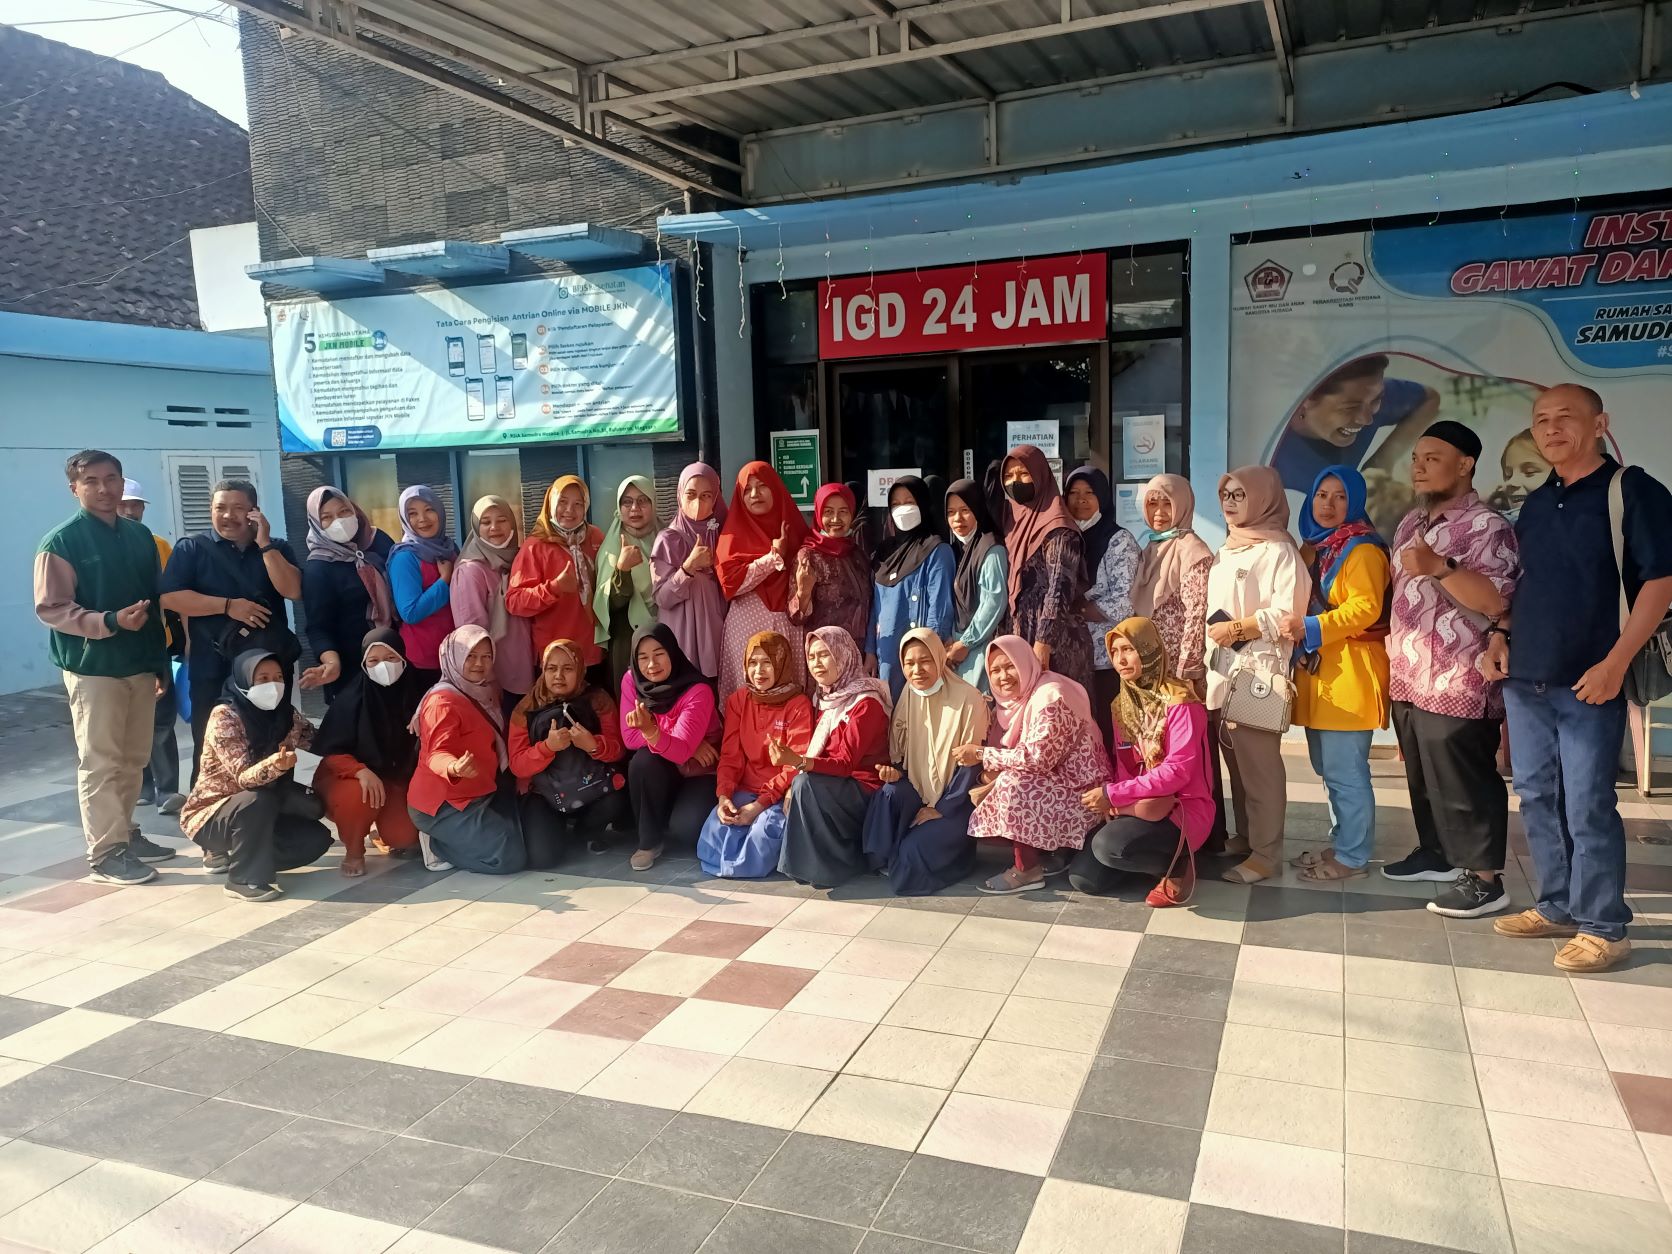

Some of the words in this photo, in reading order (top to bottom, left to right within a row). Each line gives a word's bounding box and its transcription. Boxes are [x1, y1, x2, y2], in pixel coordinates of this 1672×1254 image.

[1451, 254, 1598, 294] GAWAT
[436, 320, 452, 328] Tata
[454, 318, 472, 326] Cara
[473, 315, 509, 327] Pengisian
[512, 312, 540, 321] Antrian
[541, 309, 566, 318] Online
[582, 304, 611, 313] MOBILE
[612, 301, 628, 310] JKN
[832, 292, 906, 342] IGD
[922, 284, 977, 336] 24
[992, 273, 1090, 330] JAM
[1594, 305, 1652, 320] RUMAH
[304, 333, 316, 353] 5
[339, 339, 364, 348] MOBILE
[879, 477, 896, 485] DR
